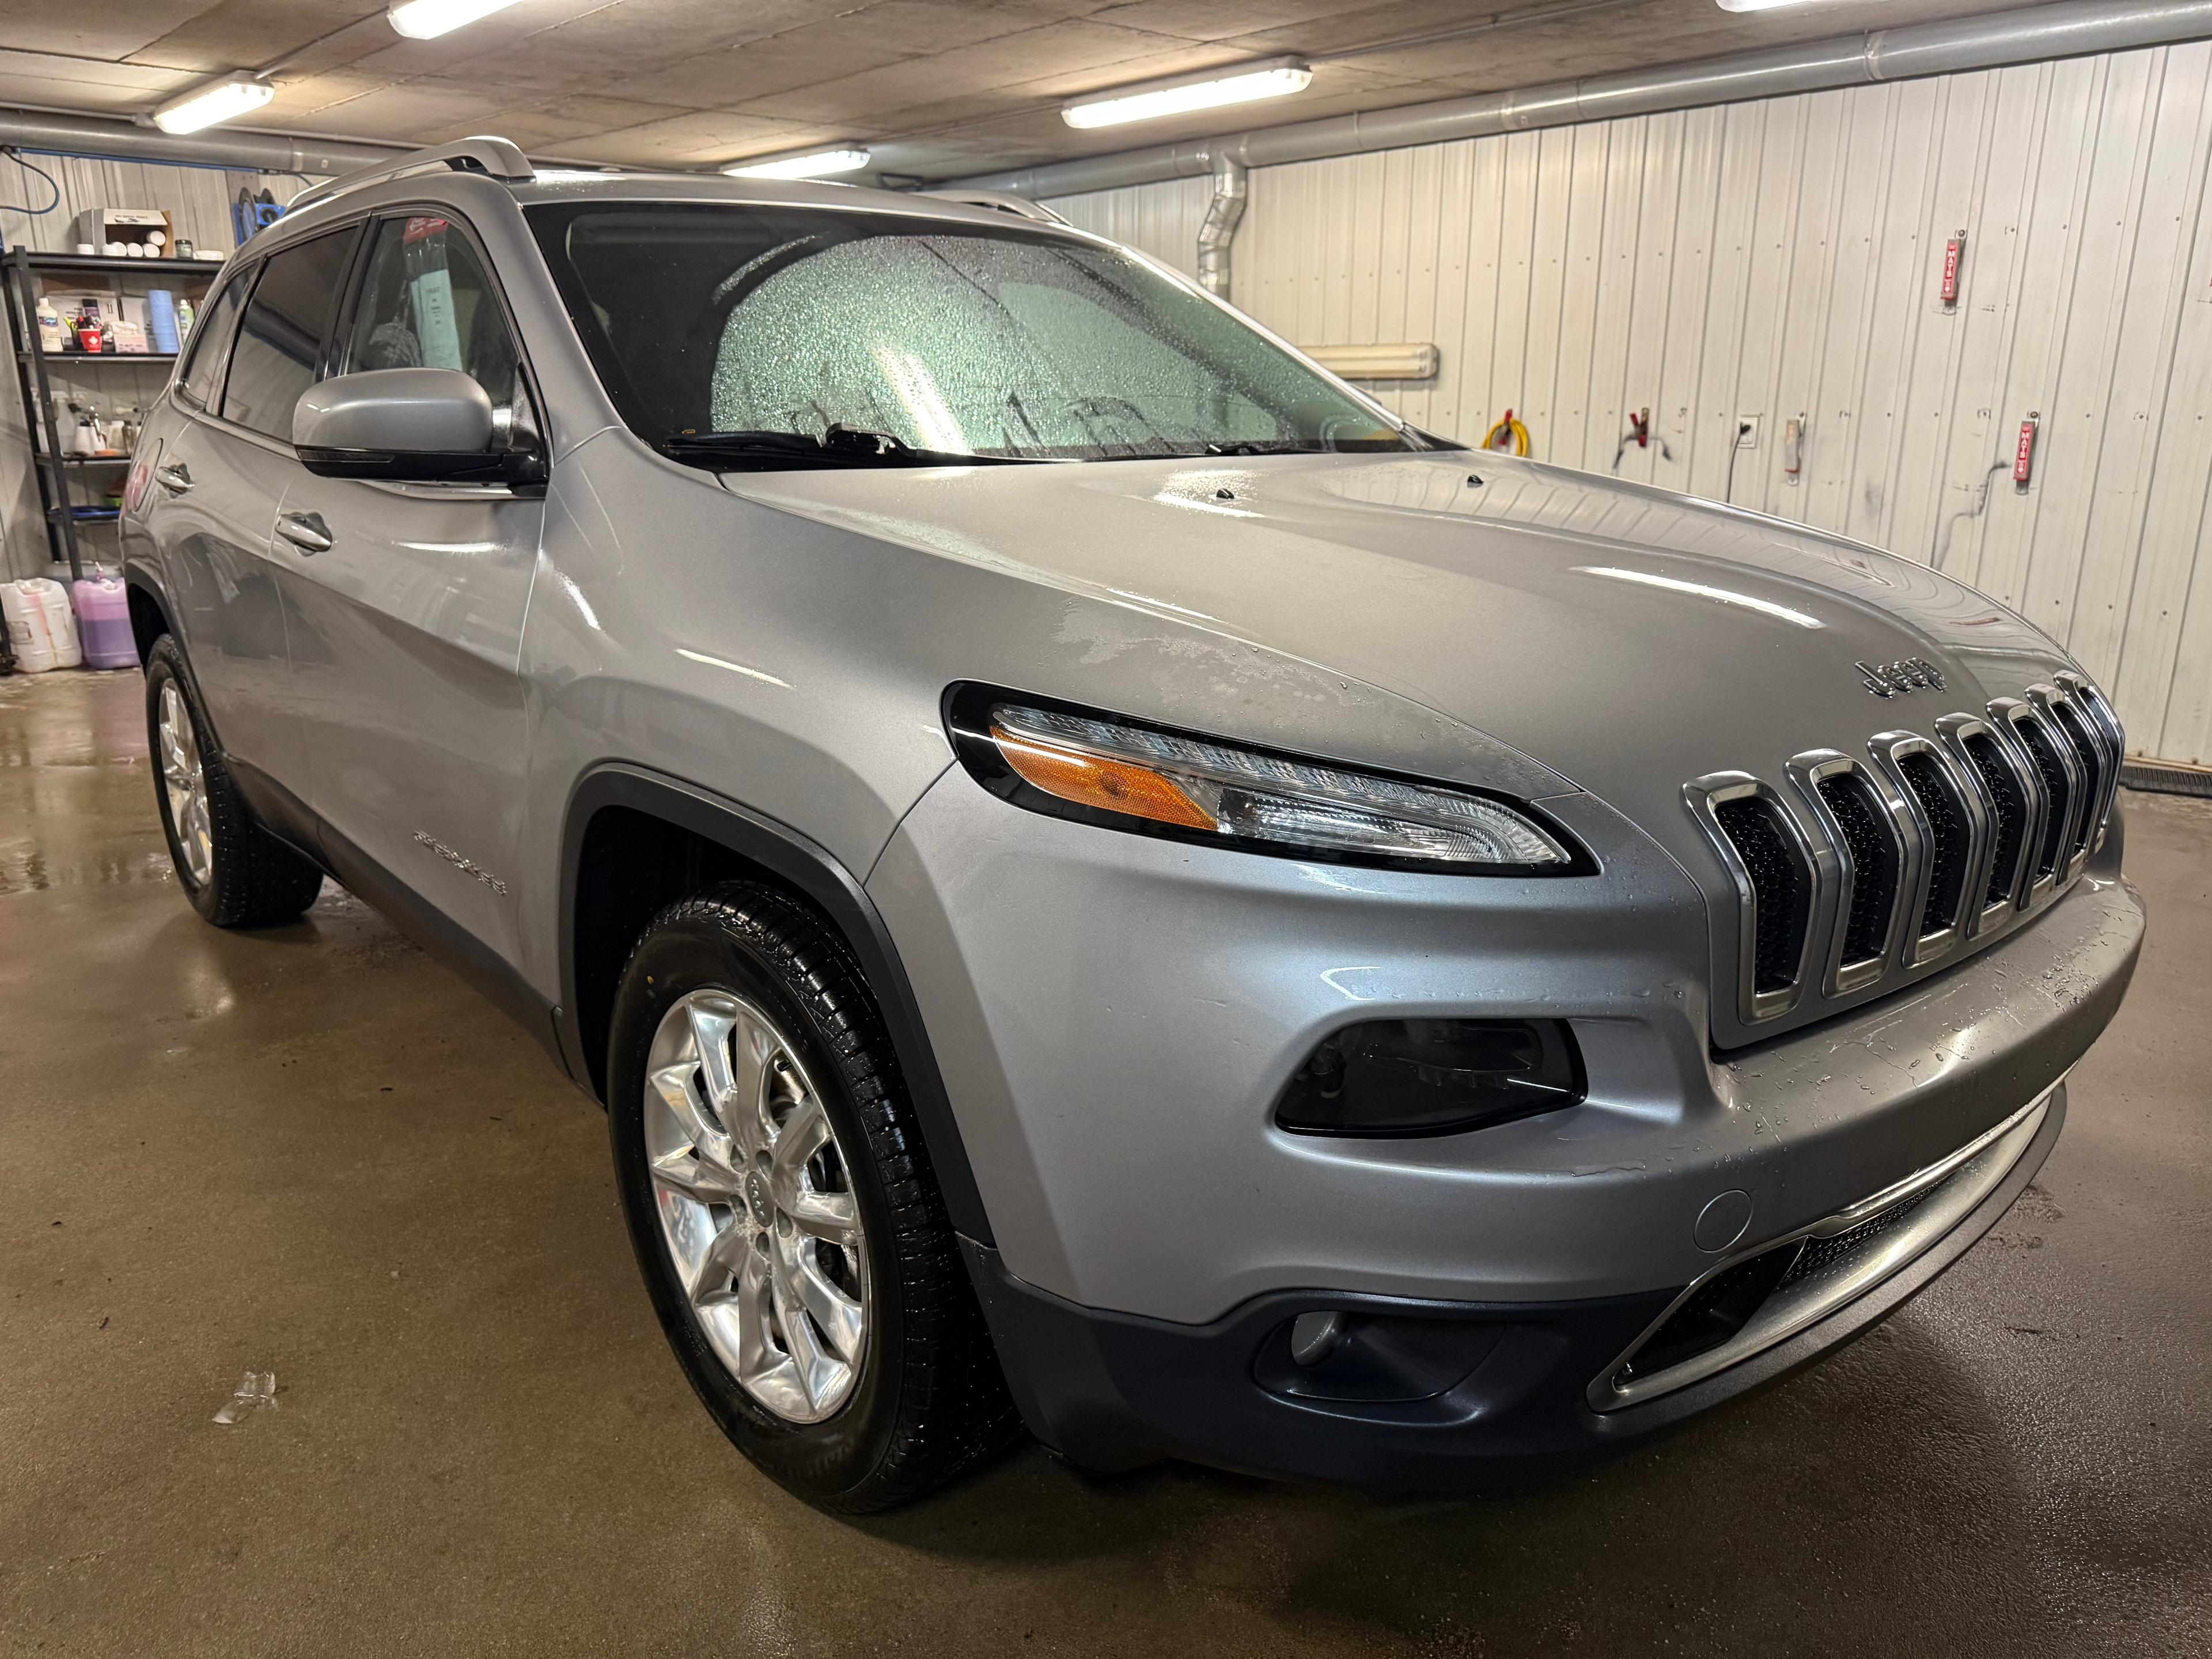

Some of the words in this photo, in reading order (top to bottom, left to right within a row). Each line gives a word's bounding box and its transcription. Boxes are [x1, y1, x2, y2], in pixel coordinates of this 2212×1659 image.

[1946, 250, 1955, 277] MATS
[2020, 432, 2029, 459] MATS
[1854, 657, 1948, 697] Jeep
